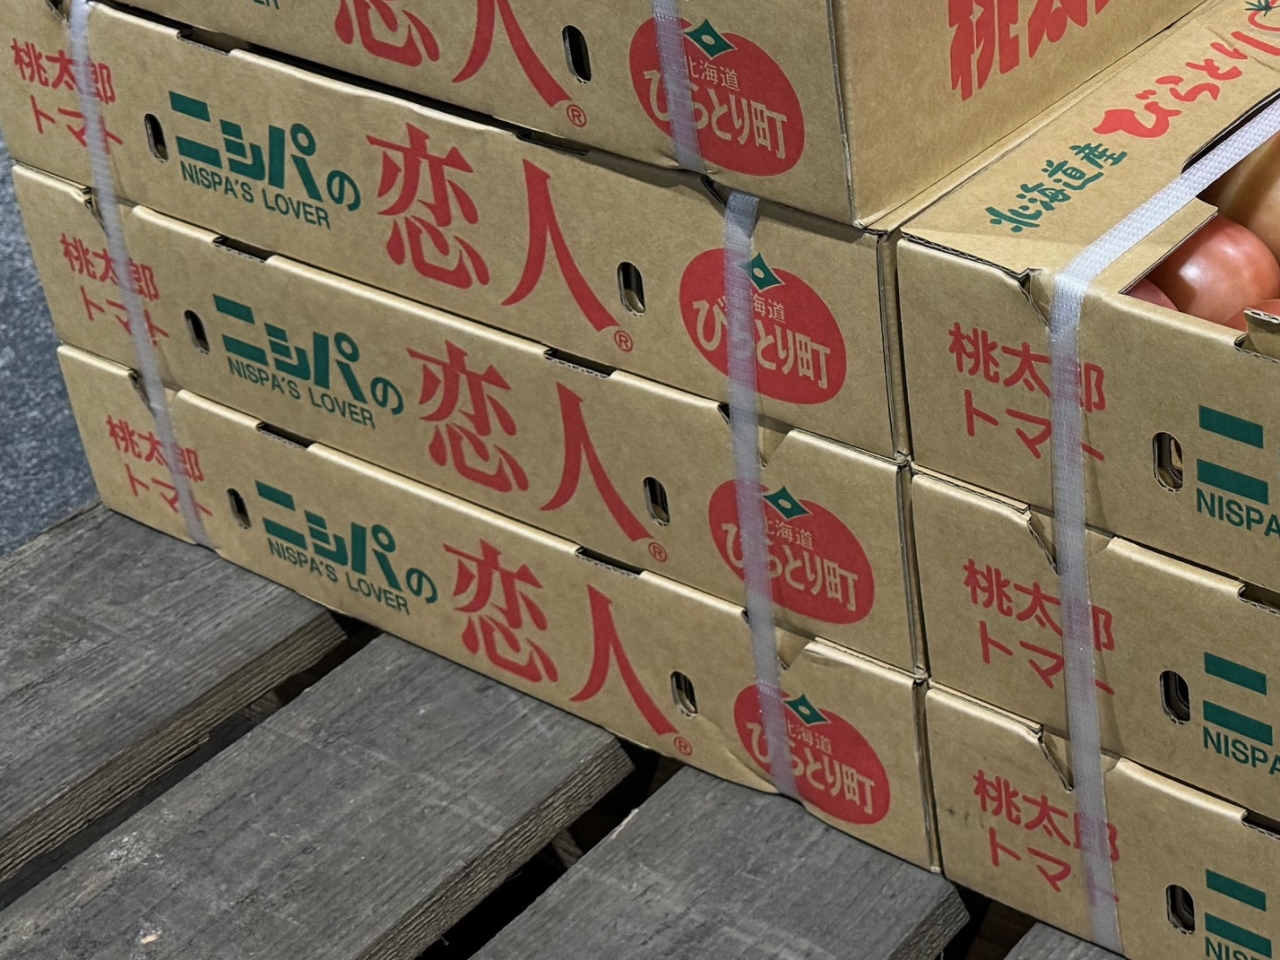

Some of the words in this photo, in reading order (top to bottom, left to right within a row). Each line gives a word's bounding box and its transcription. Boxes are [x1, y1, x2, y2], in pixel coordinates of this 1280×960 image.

[180, 161, 256, 205] NISPA'S
[262, 187, 332, 230] LOVER
[368, 125, 617, 330] 恋人
[985, 143, 1129, 234] 北海道産
[692, 295, 831, 390] びとり町
[227, 357, 303, 401] NISPA'S
[309, 384, 376, 429] LOVER
[410, 343, 648, 540] 恋人
[267, 537, 342, 584] NISPA'S
[346, 569, 411, 616] LOVER
[446, 543, 675, 734] 恋人
